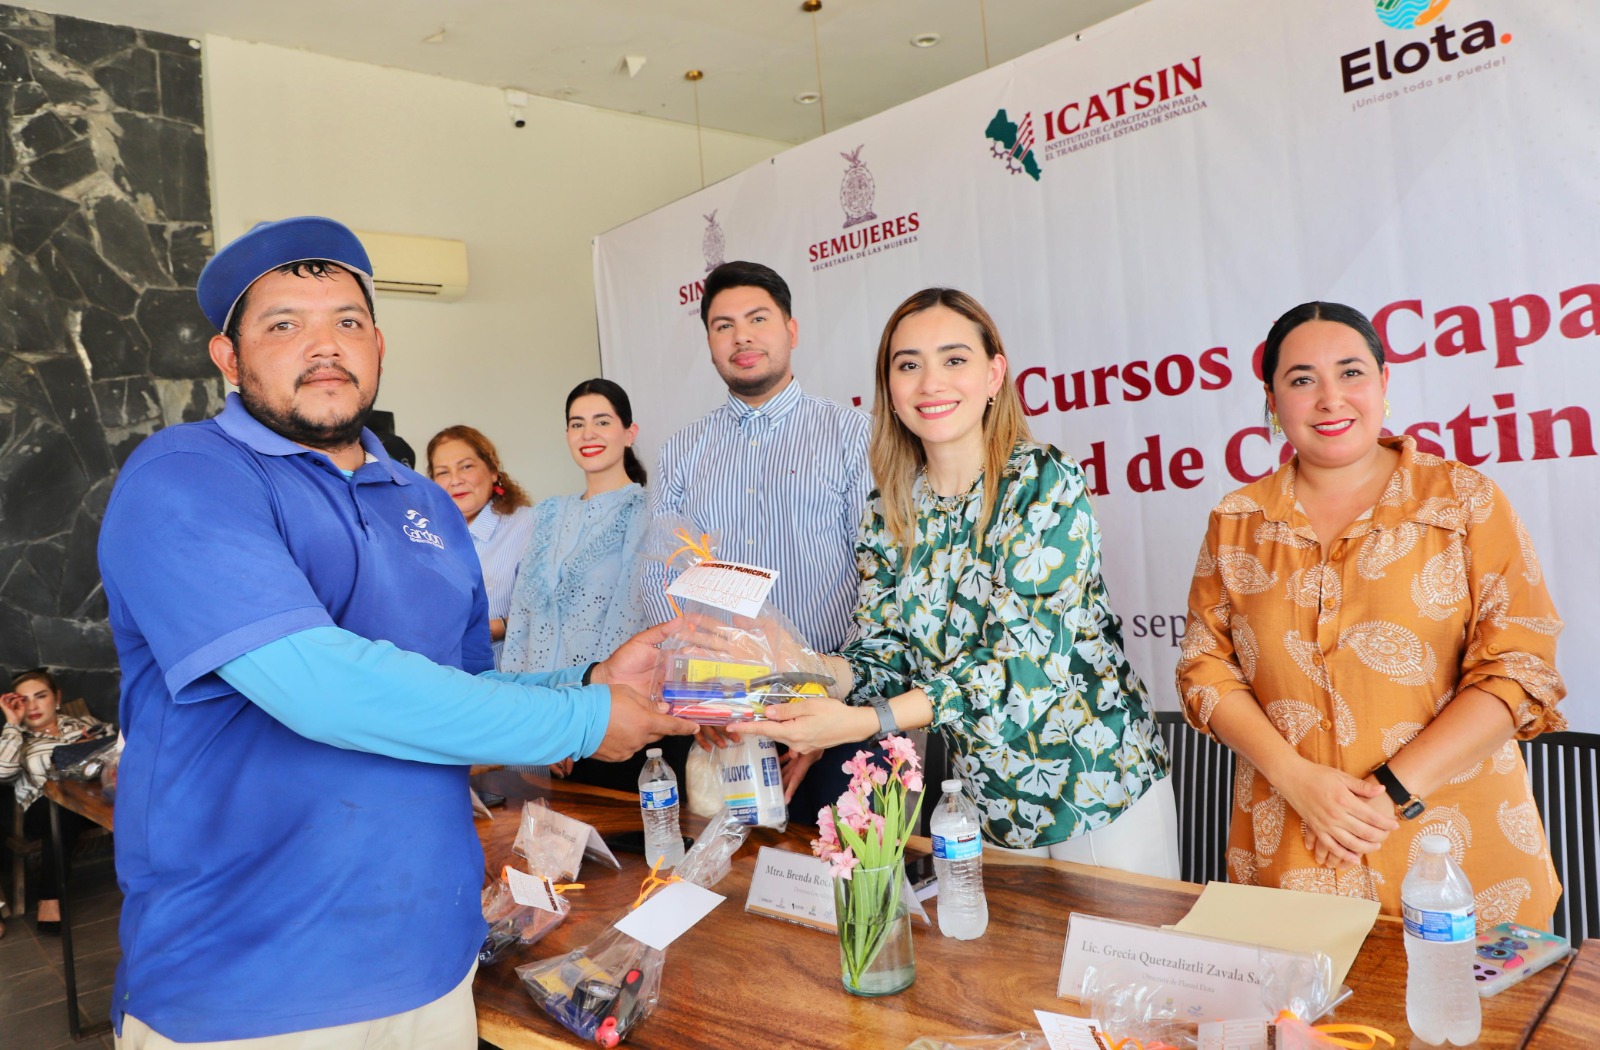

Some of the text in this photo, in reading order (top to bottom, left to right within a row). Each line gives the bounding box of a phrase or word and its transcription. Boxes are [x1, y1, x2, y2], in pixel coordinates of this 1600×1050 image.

[1340, 20, 1512, 93] Elota.
[1044, 55, 1202, 142] ICATSIN
[1352, 56, 1506, 111] ¡Unidos todo se puede!
[1045, 94, 1199, 152] INSTITUTO DE CAPACITACIÓN PARA
[1045, 101, 1208, 161] EL TRABAJO DEL ESTADO DE SINALOA
[809, 212, 920, 262] SEMUJERES
[812, 235, 918, 272] SECRETARÍA DE LAS MUJERES
[679, 279, 707, 305] SIN
[1015, 347, 1232, 416] Cursos
[1127, 434, 1217, 494] de
[734, 565, 771, 579] MUNICIPAL
[1133, 614, 1187, 647] sep
[766, 865, 785, 878] Mtra.
[786, 869, 812, 883] Brenda
[1082, 940, 1261, 985] Lic. Grecia Quetzaliztli Zavala Sa
